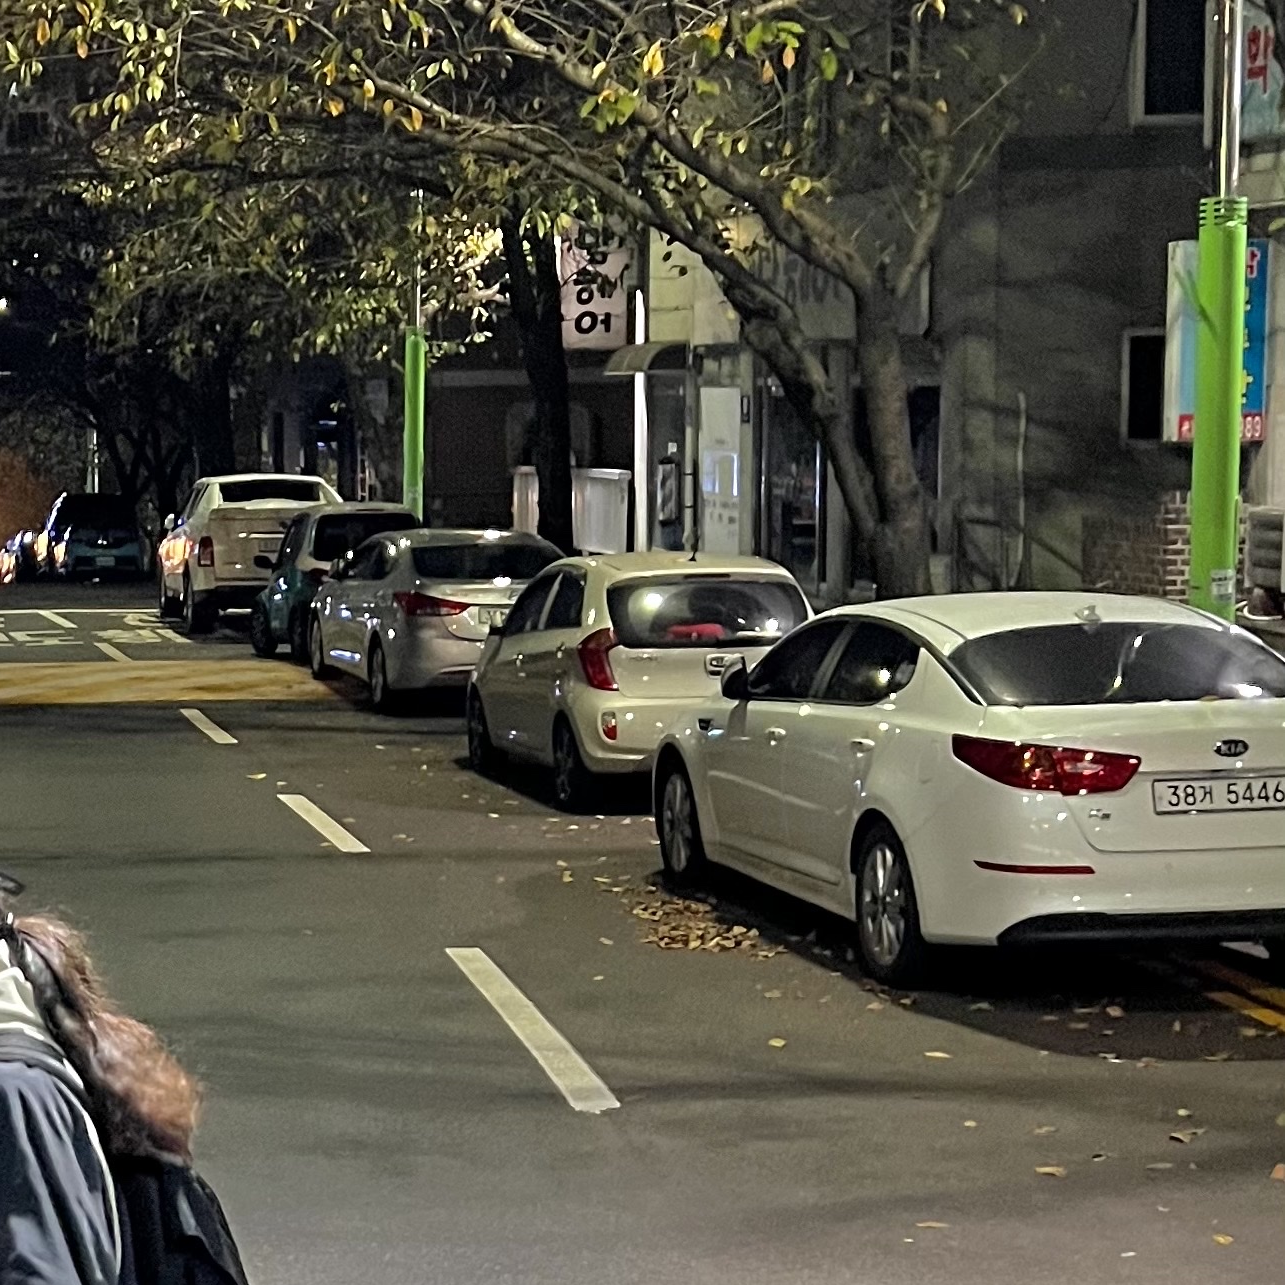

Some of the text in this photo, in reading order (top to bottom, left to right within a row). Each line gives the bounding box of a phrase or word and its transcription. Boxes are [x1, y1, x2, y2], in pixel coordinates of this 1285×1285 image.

[1220, 743, 1245, 754] KIA
[1166, 780, 1285, 807] 38거 5446
